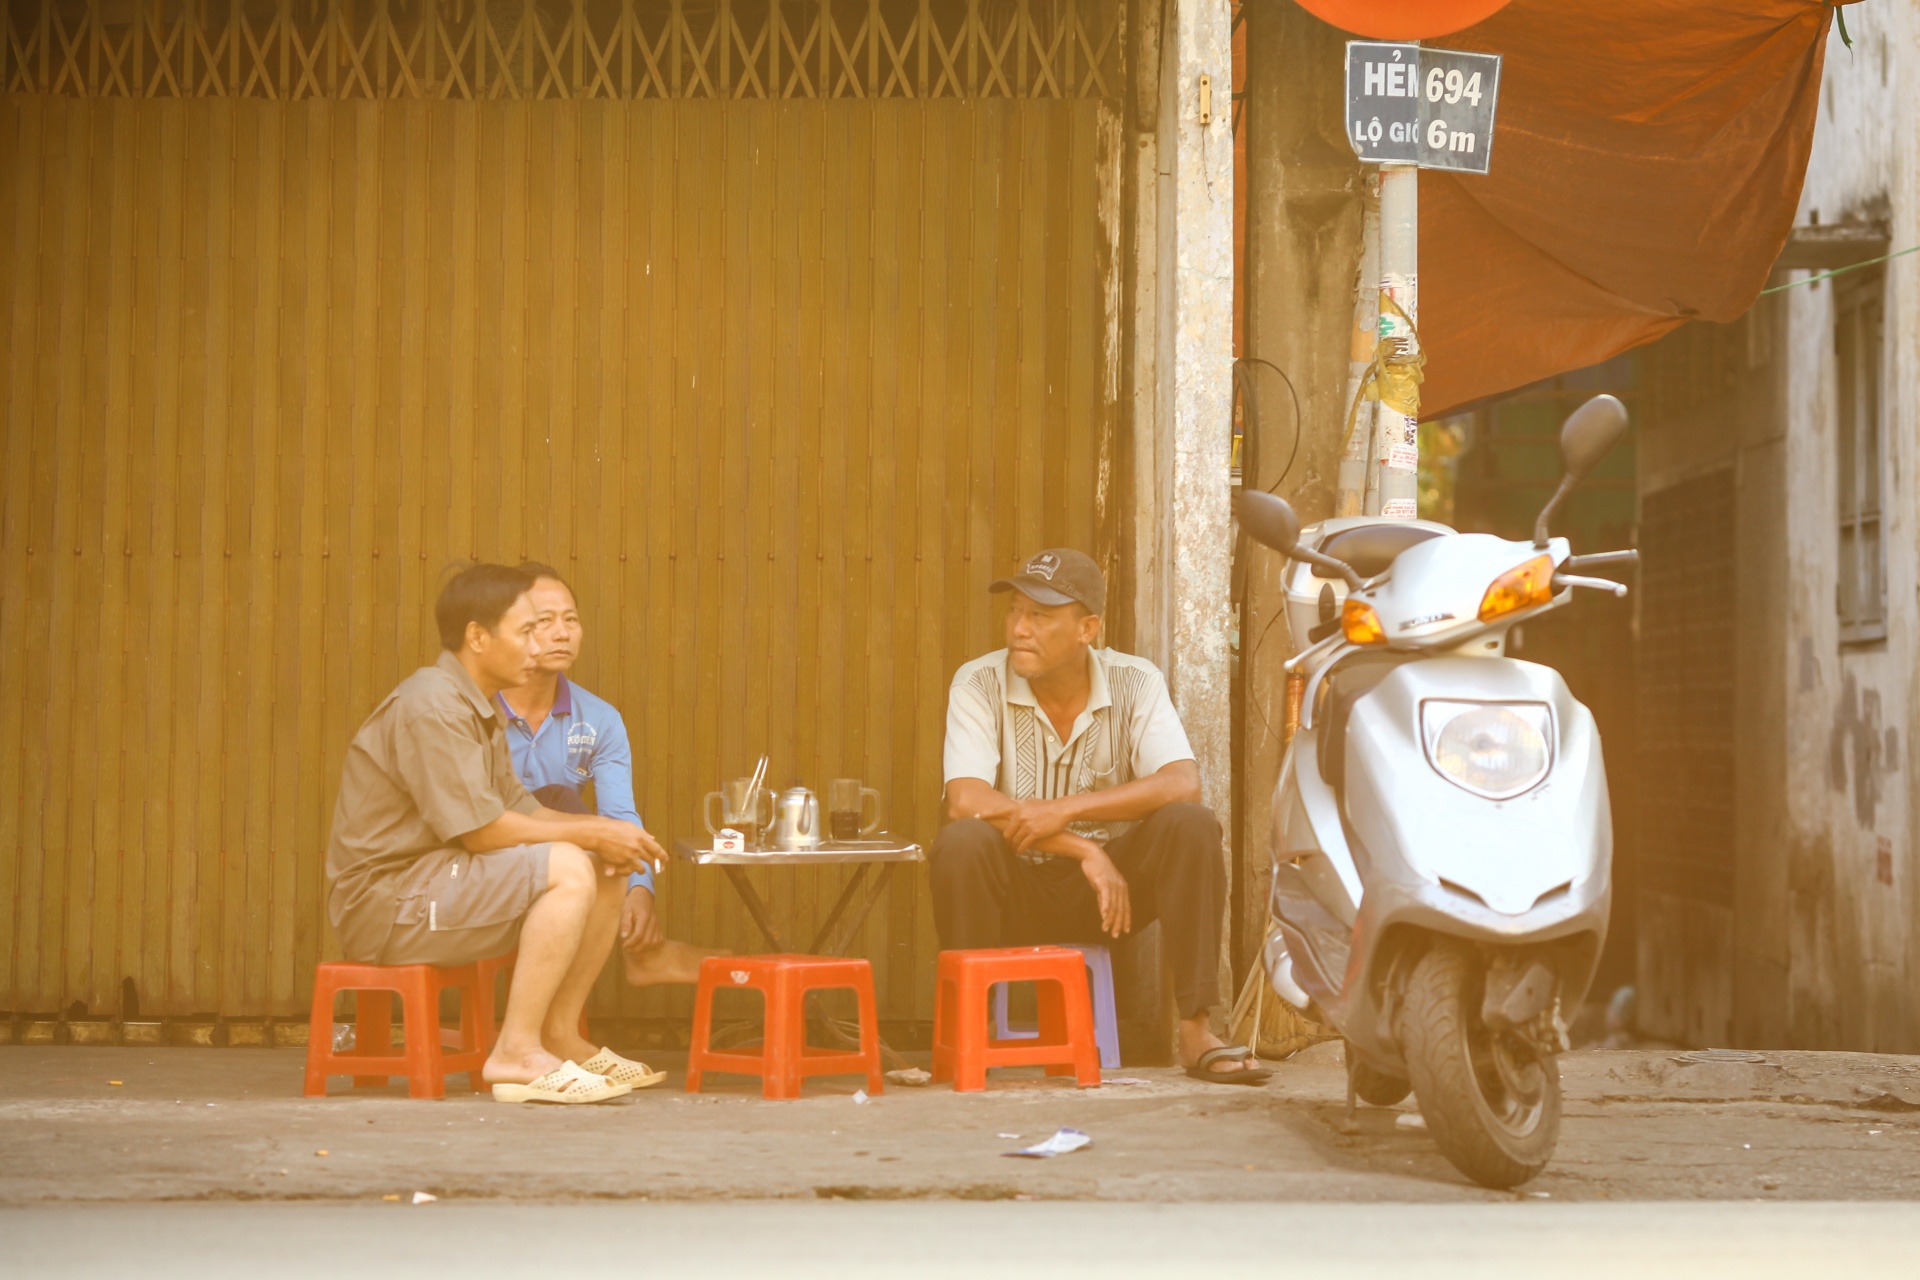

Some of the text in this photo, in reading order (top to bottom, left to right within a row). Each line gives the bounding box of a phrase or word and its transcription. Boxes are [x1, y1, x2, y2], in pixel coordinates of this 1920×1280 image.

[1425, 67, 1483, 107] 694
[1355, 116, 1383, 148] LỘ
[1427, 119, 1476, 153] 6m
